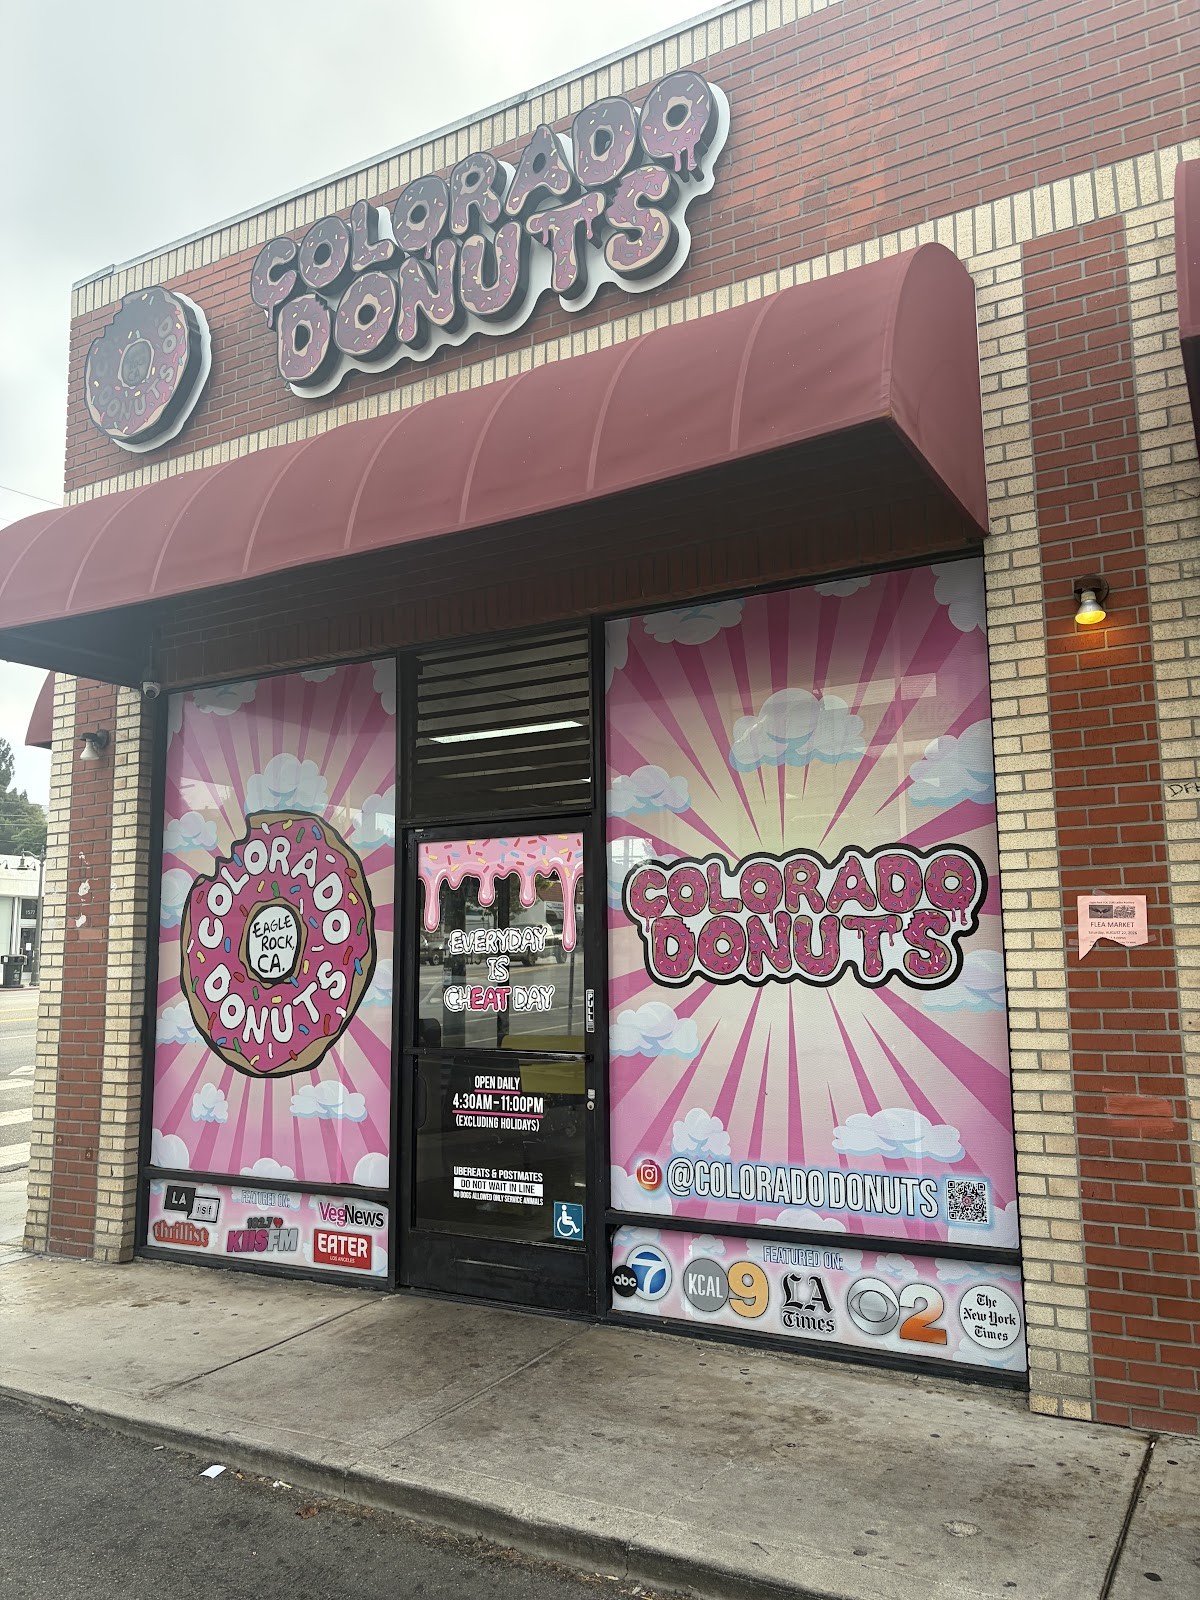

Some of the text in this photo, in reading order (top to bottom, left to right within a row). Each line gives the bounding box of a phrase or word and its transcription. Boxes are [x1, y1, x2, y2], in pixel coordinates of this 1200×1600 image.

[250, 70, 714, 327] COLORADO
[276, 164, 673, 383] DONUTS
[198, 836, 351, 949] COLORADO
[629, 855, 977, 924] COLORADO
[252, 915, 293, 938] EAGLE
[262, 935, 294, 951] ROCK,
[449, 927, 548, 954] EVERYDAY
[652, 910, 951, 978] DONUTS
[258, 953, 285, 973] CA.
[487, 955, 510, 982] IS
[203, 960, 347, 1044] DONUTS
[444, 984, 555, 1012] CHEAT DAY
[474, 1075, 520, 1090] OPEN DAILY
[455, 1114, 540, 1132] (EXCLUDING HOLIDAYS)
[453, 1166, 543, 1182] UBEREATS & POSTMATES
[460, 1178, 536, 1194] DO NOT WAIT IN LINE
[241, 1189, 277, 1206] FEATURED
[453, 1190, 460, 1198] NO
[460, 1191, 472, 1199] DOGS
[471, 1192, 493, 1201] ALLOWED
[522, 1196, 544, 1206] ANIMALS
[319, 1201, 385, 1227] VegNews
[153, 1220, 207, 1244] thrillist
[317, 1233, 368, 1258] EATER
[763, 1245, 843, 1270] FEATURED ON:
[338, 1256, 355, 1264] ANGELES
[613, 1273, 637, 1288] abc
[688, 1260, 769, 1319] KCAL 9
[782, 1273, 834, 1313] LA
[976, 1293, 997, 1309] The
[782, 1310, 835, 1333] Times
[900, 1283, 947, 1345] 2
[963, 1307, 1016, 1327] New York
[974, 1324, 1008, 1341] Times
